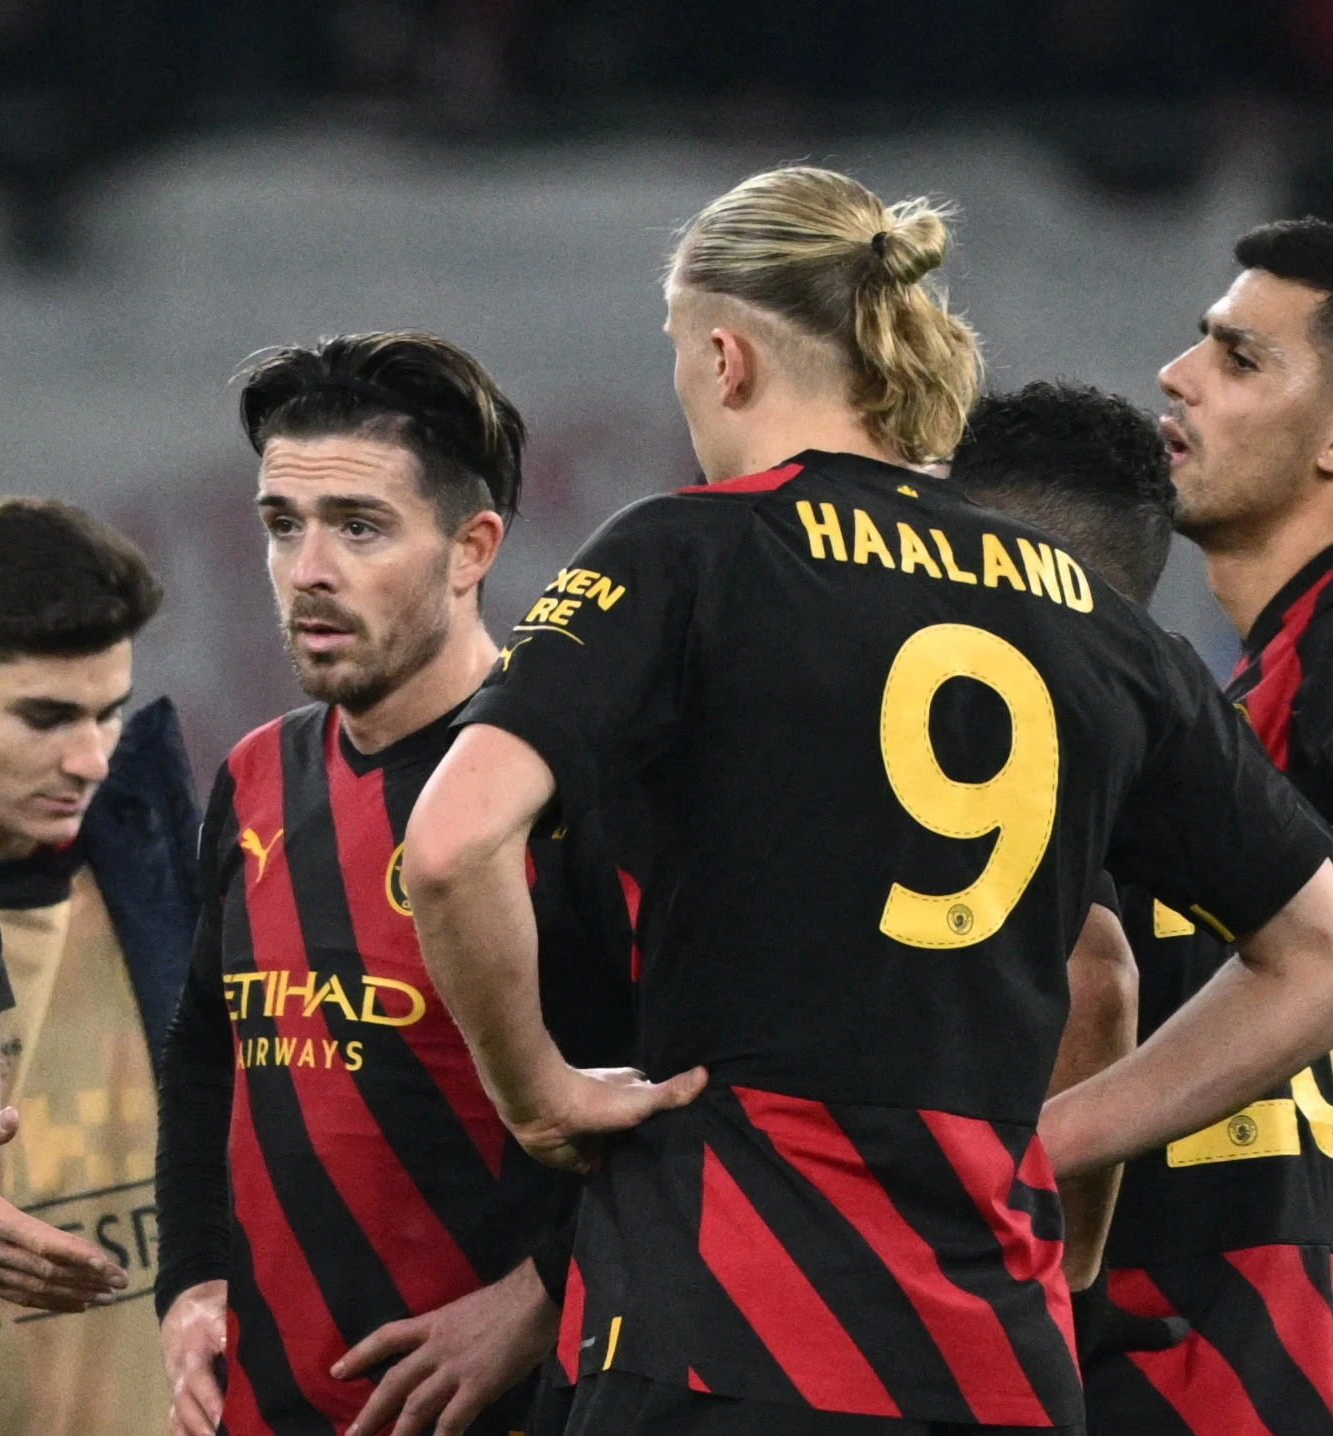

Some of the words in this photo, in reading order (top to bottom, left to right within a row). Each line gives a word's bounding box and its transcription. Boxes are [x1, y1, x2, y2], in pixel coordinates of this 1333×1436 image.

[795, 500, 1094, 613] HAALAND
[879, 622, 1060, 949] 9
[222, 970, 427, 1027] ETIHAD
[237, 1036, 364, 1072] AIRWAYS
